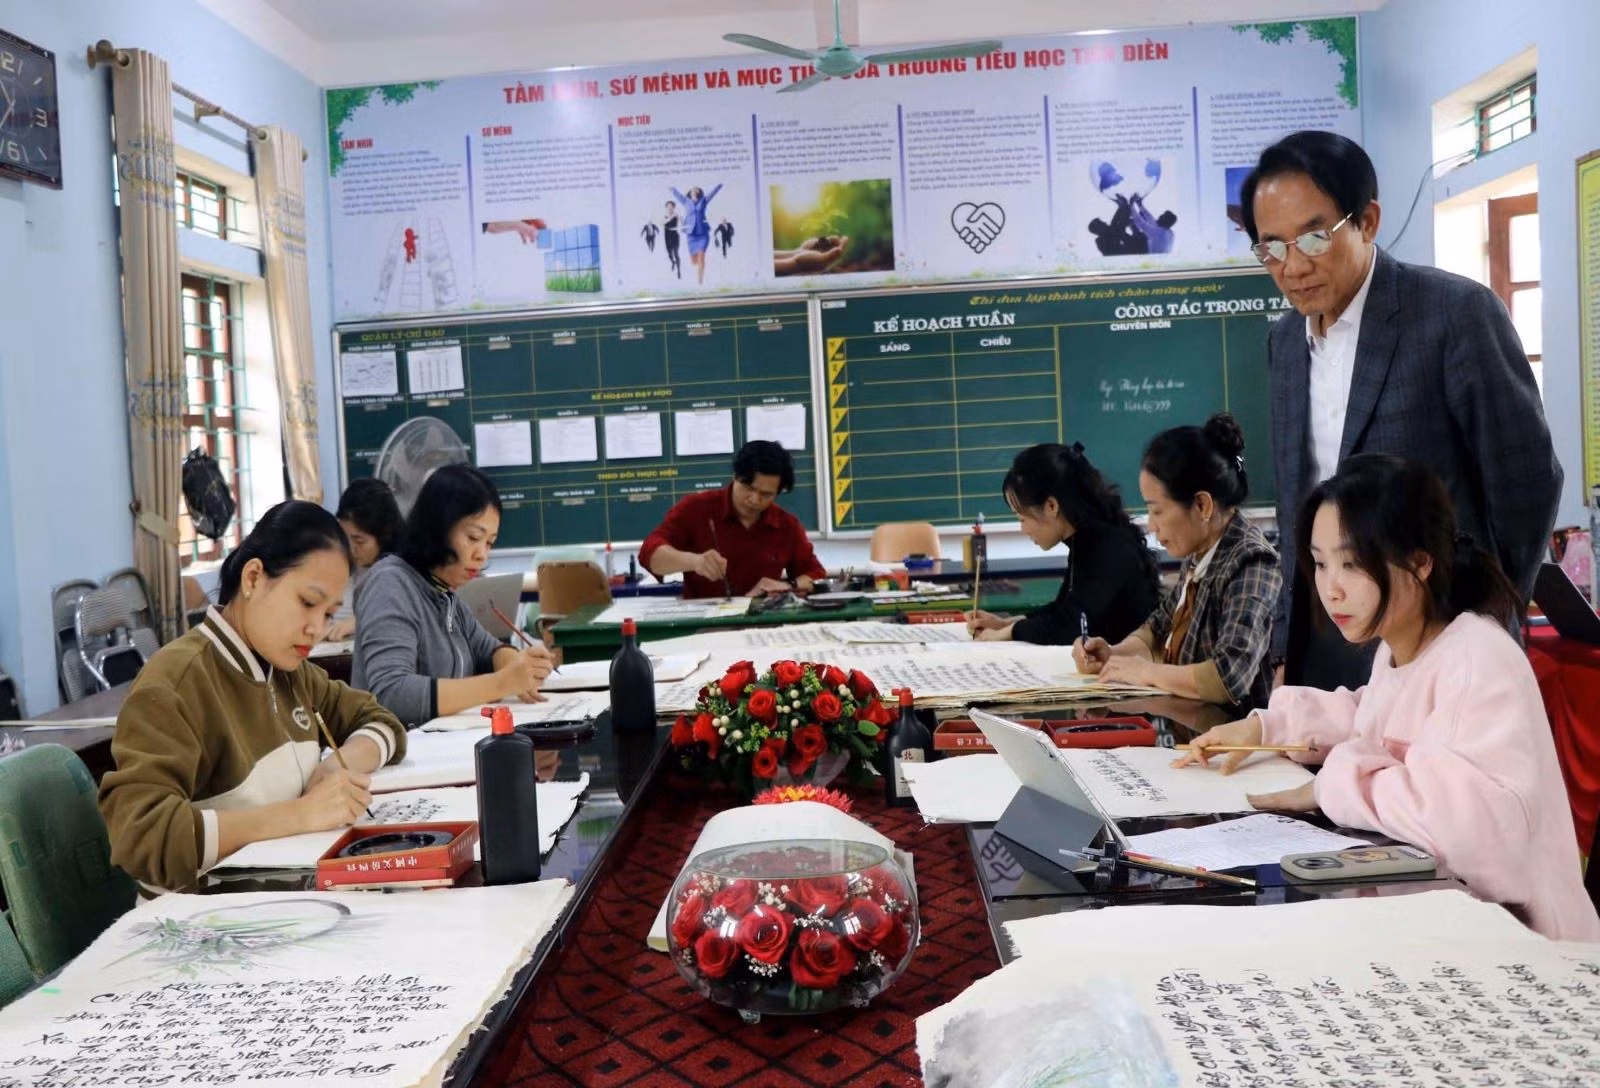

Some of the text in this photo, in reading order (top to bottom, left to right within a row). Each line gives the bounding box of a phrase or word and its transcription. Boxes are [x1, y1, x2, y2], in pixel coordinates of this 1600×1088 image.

[610, 75, 637, 96] SỨ
[643, 72, 697, 95] MỆNH
[705, 68, 730, 88] VÀ
[737, 67, 782, 88] MỤC
[1024, 49, 1065, 70] HỌC
[1115, 302, 1164, 319] CÔNG
[1167, 299, 1201, 316] TÁC
[1204, 298, 1266, 315] TRỌNG
[873, 309, 1016, 333] KẾ HOẠCH TUẦN
[1110, 320, 1171, 331] CHUYÊN MÔN
[879, 341, 911, 353] SÁNG
[979, 335, 1011, 347] CHIỀU
